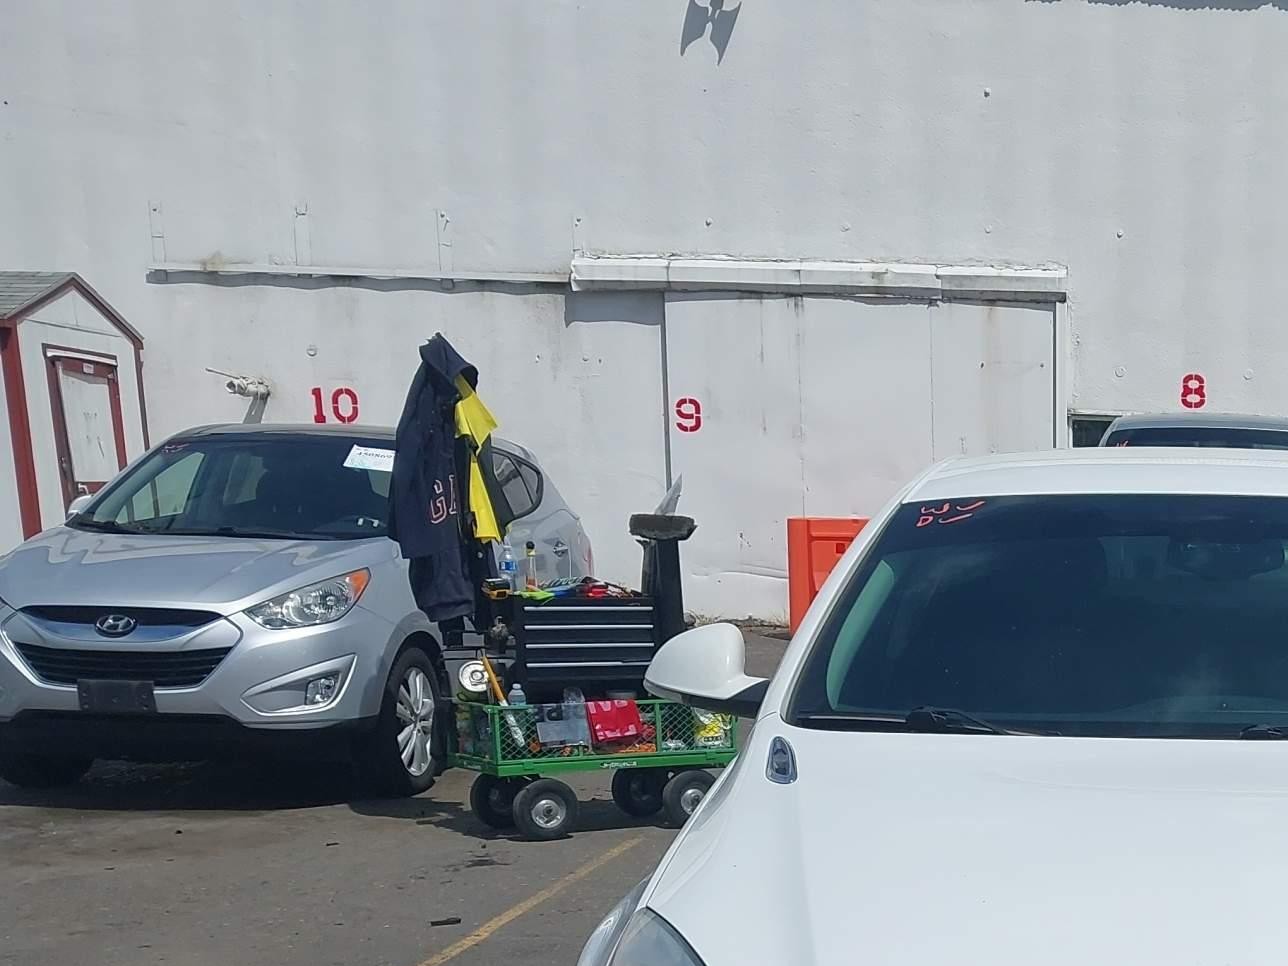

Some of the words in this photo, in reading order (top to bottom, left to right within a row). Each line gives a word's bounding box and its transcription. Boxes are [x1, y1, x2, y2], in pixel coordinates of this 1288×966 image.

[311, 387, 359, 424] 10
[1181, 374, 1206, 409] 8
[676, 398, 701, 432] 9
